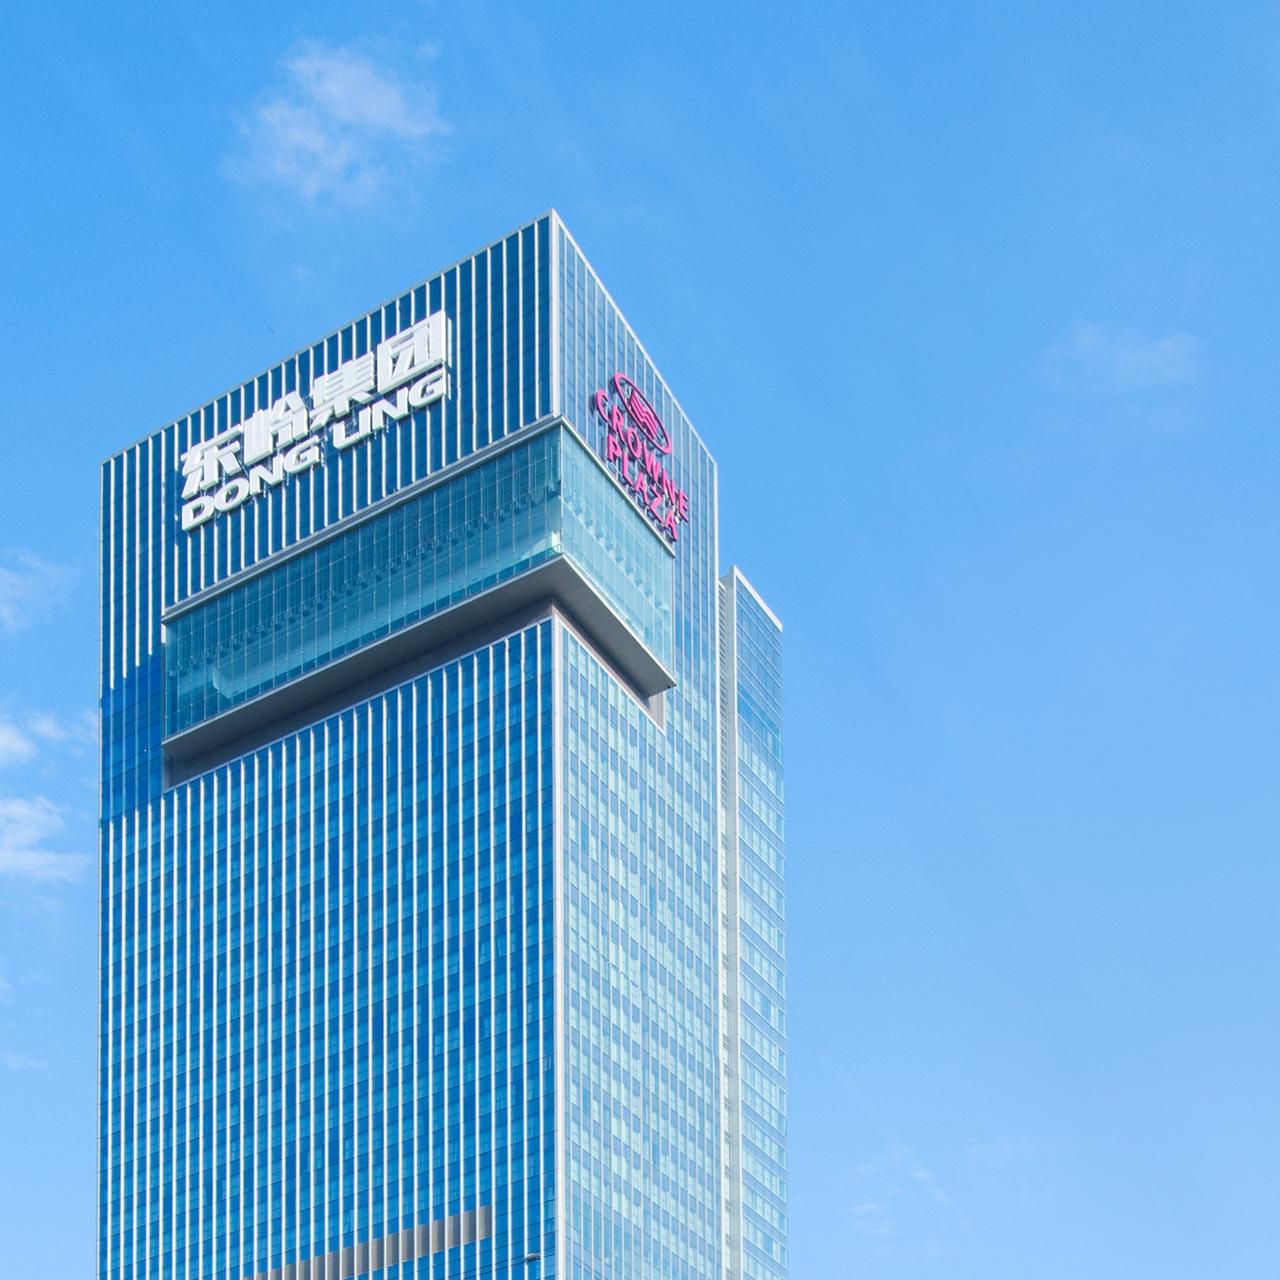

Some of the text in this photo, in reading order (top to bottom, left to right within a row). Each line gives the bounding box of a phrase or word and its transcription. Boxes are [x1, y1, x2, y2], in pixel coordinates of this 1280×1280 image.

[180, 310, 453, 500] 东岭集团
[181, 361, 449, 532] DONG LING
[596, 389, 689, 522] CROWNE
[607, 433, 679, 541] PLAZA
